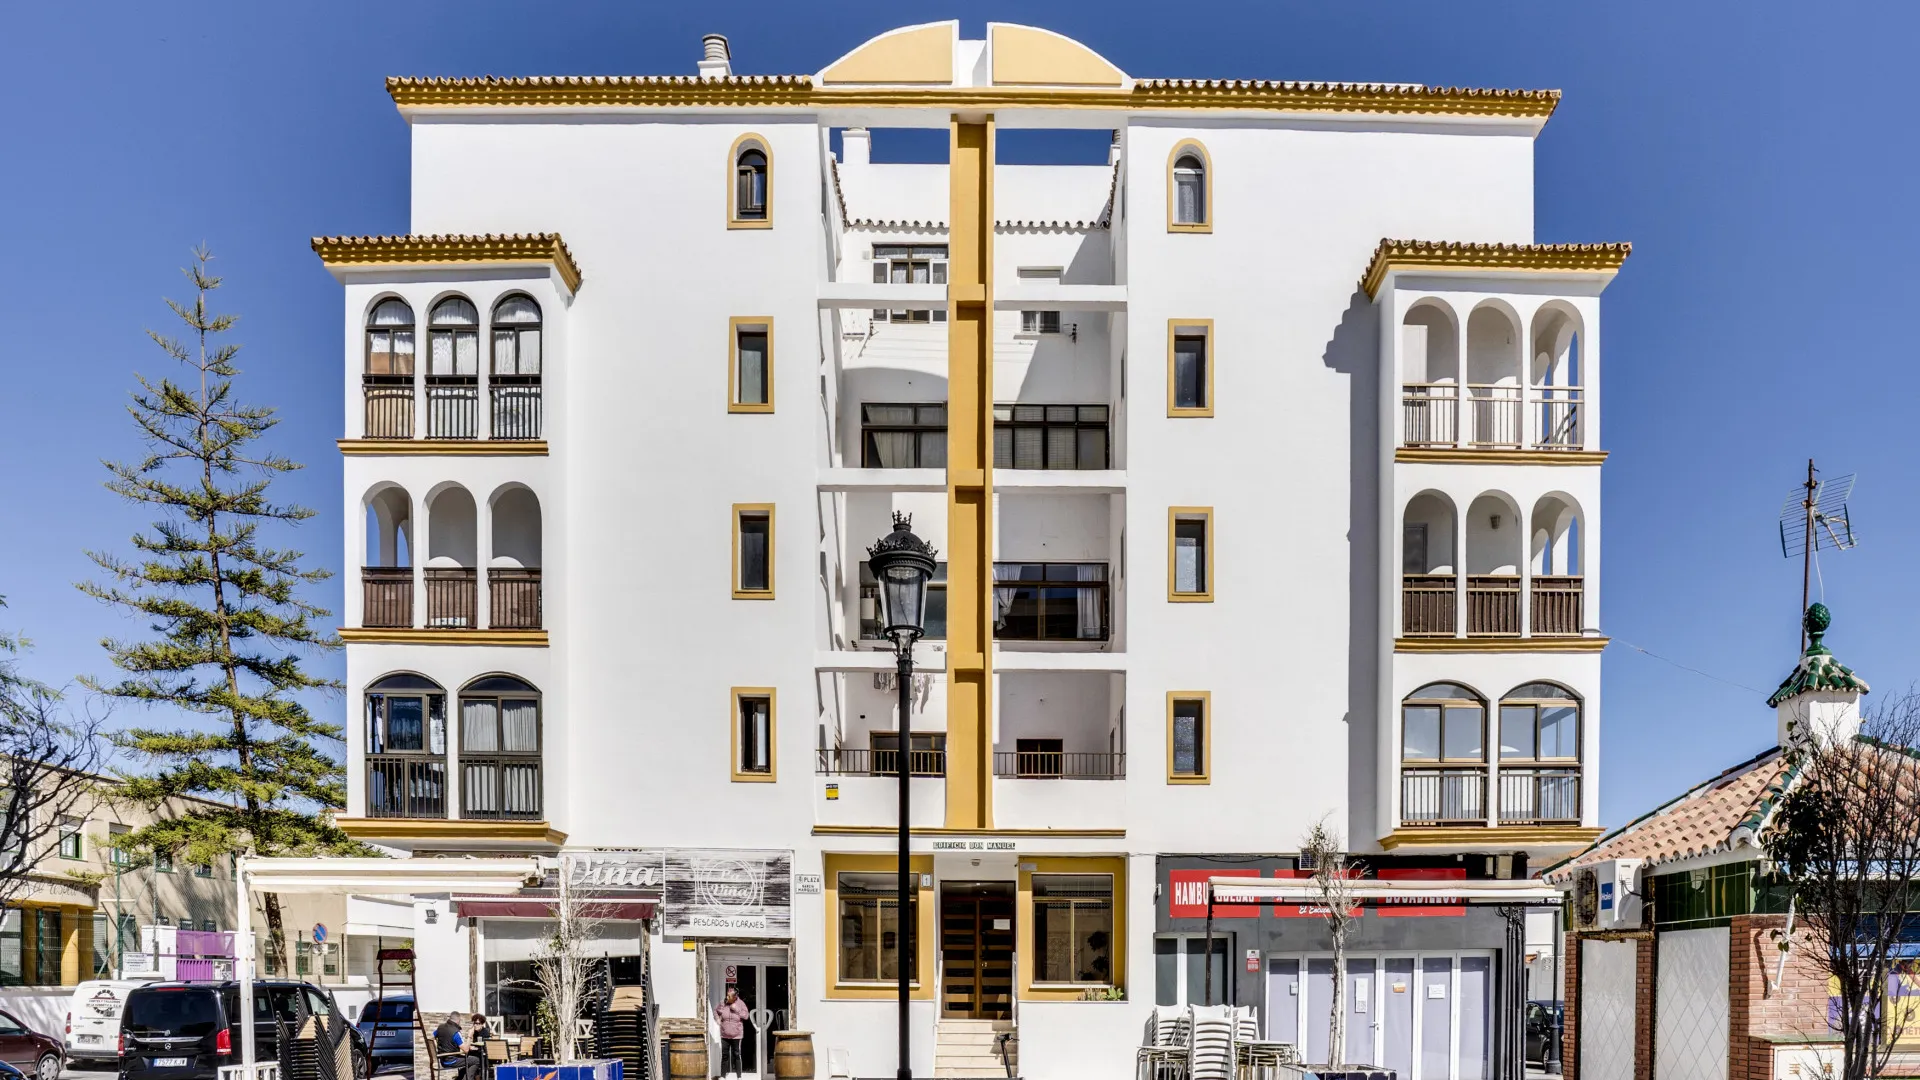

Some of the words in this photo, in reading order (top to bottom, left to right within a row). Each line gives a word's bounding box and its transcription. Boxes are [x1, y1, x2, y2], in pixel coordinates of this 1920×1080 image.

[932, 841, 966, 850] EDIFICIO
[969, 841, 984, 850] DON
[987, 842, 1016, 850] MANUEL
[693, 918, 730, 928] PESCADOS
[731, 920, 736, 928] Y
[736, 920, 765, 929] CARNES
